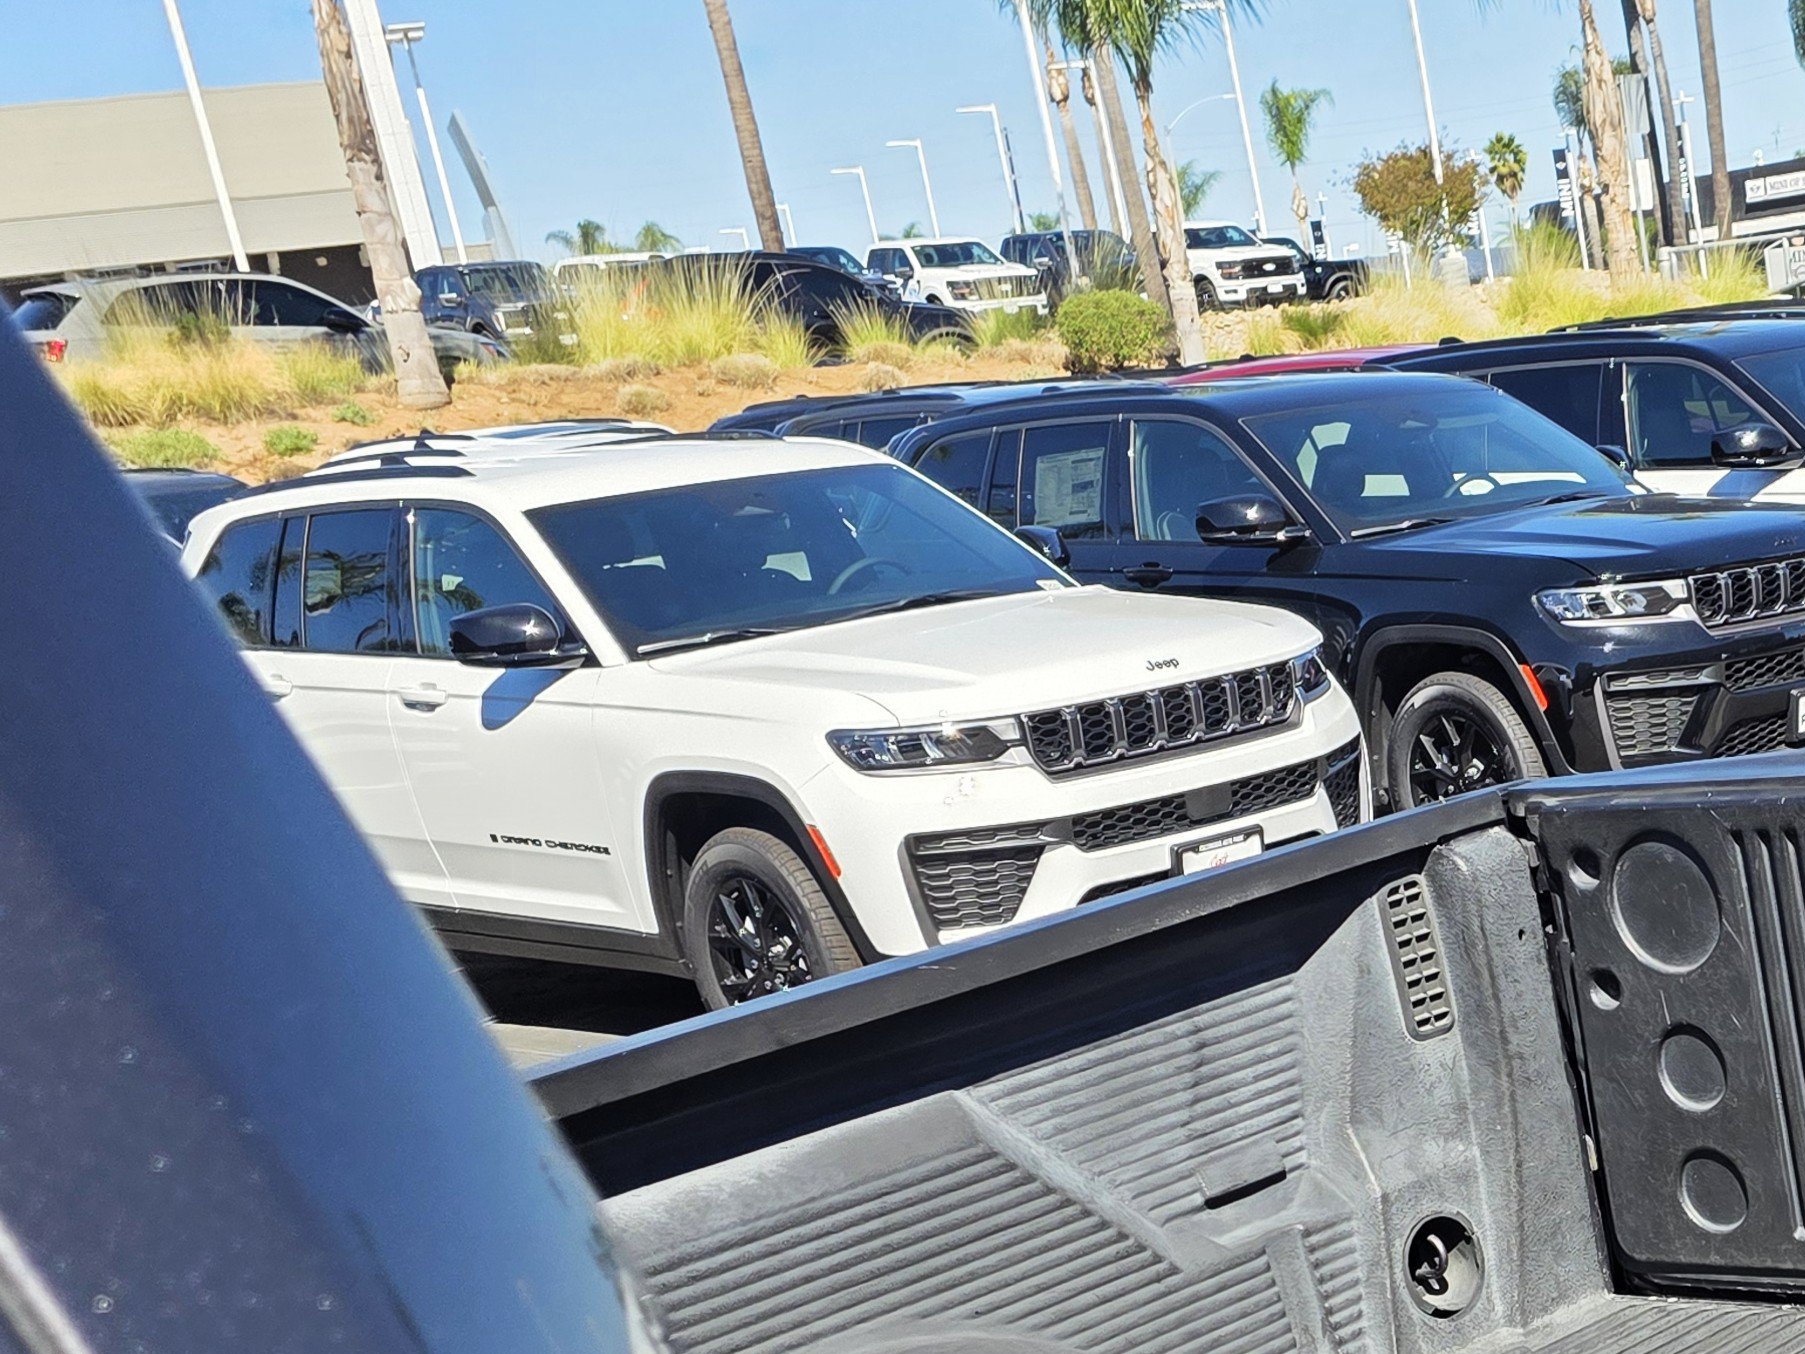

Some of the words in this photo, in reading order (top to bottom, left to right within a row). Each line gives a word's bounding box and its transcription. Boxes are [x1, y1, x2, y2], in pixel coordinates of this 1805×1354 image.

[1557, 178, 1576, 218] MINI
[1146, 658, 1179, 671] Jeep
[500, 835, 542, 847] GRAND
[545, 840, 611, 855] CHEROKEE
